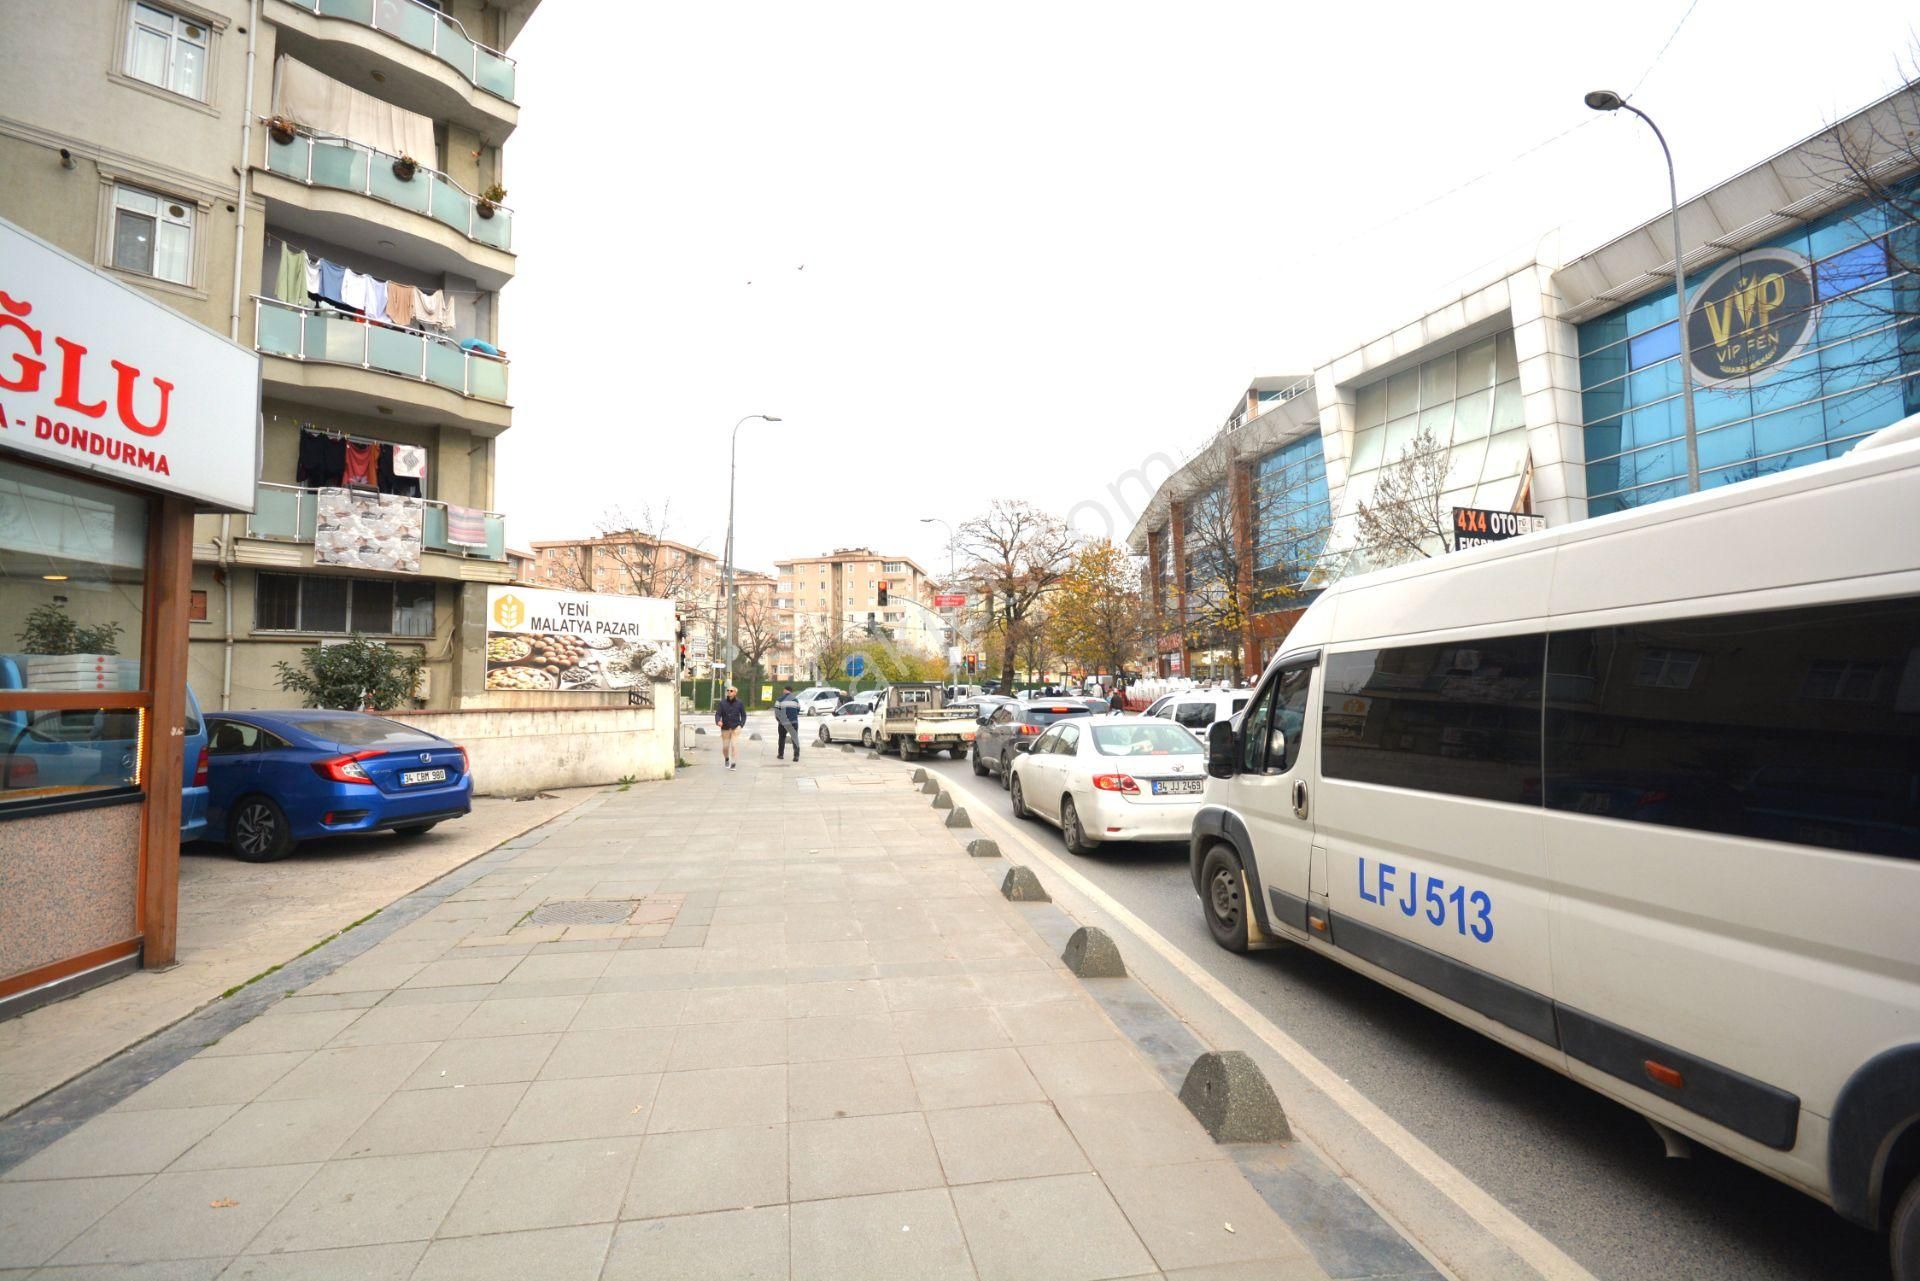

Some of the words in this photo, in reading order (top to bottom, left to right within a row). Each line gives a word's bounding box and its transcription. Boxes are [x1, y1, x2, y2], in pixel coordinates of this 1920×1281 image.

[1747, 330, 1780, 353] FEN
[34, 414, 170, 476] DONDURMA
[1457, 509, 1487, 533] 4X4
[1490, 512, 1517, 535] OTO
[558, 600, 589, 617] YENİ
[530, 616, 593, 634] MALATYA
[596, 621, 640, 637] PAZARI
